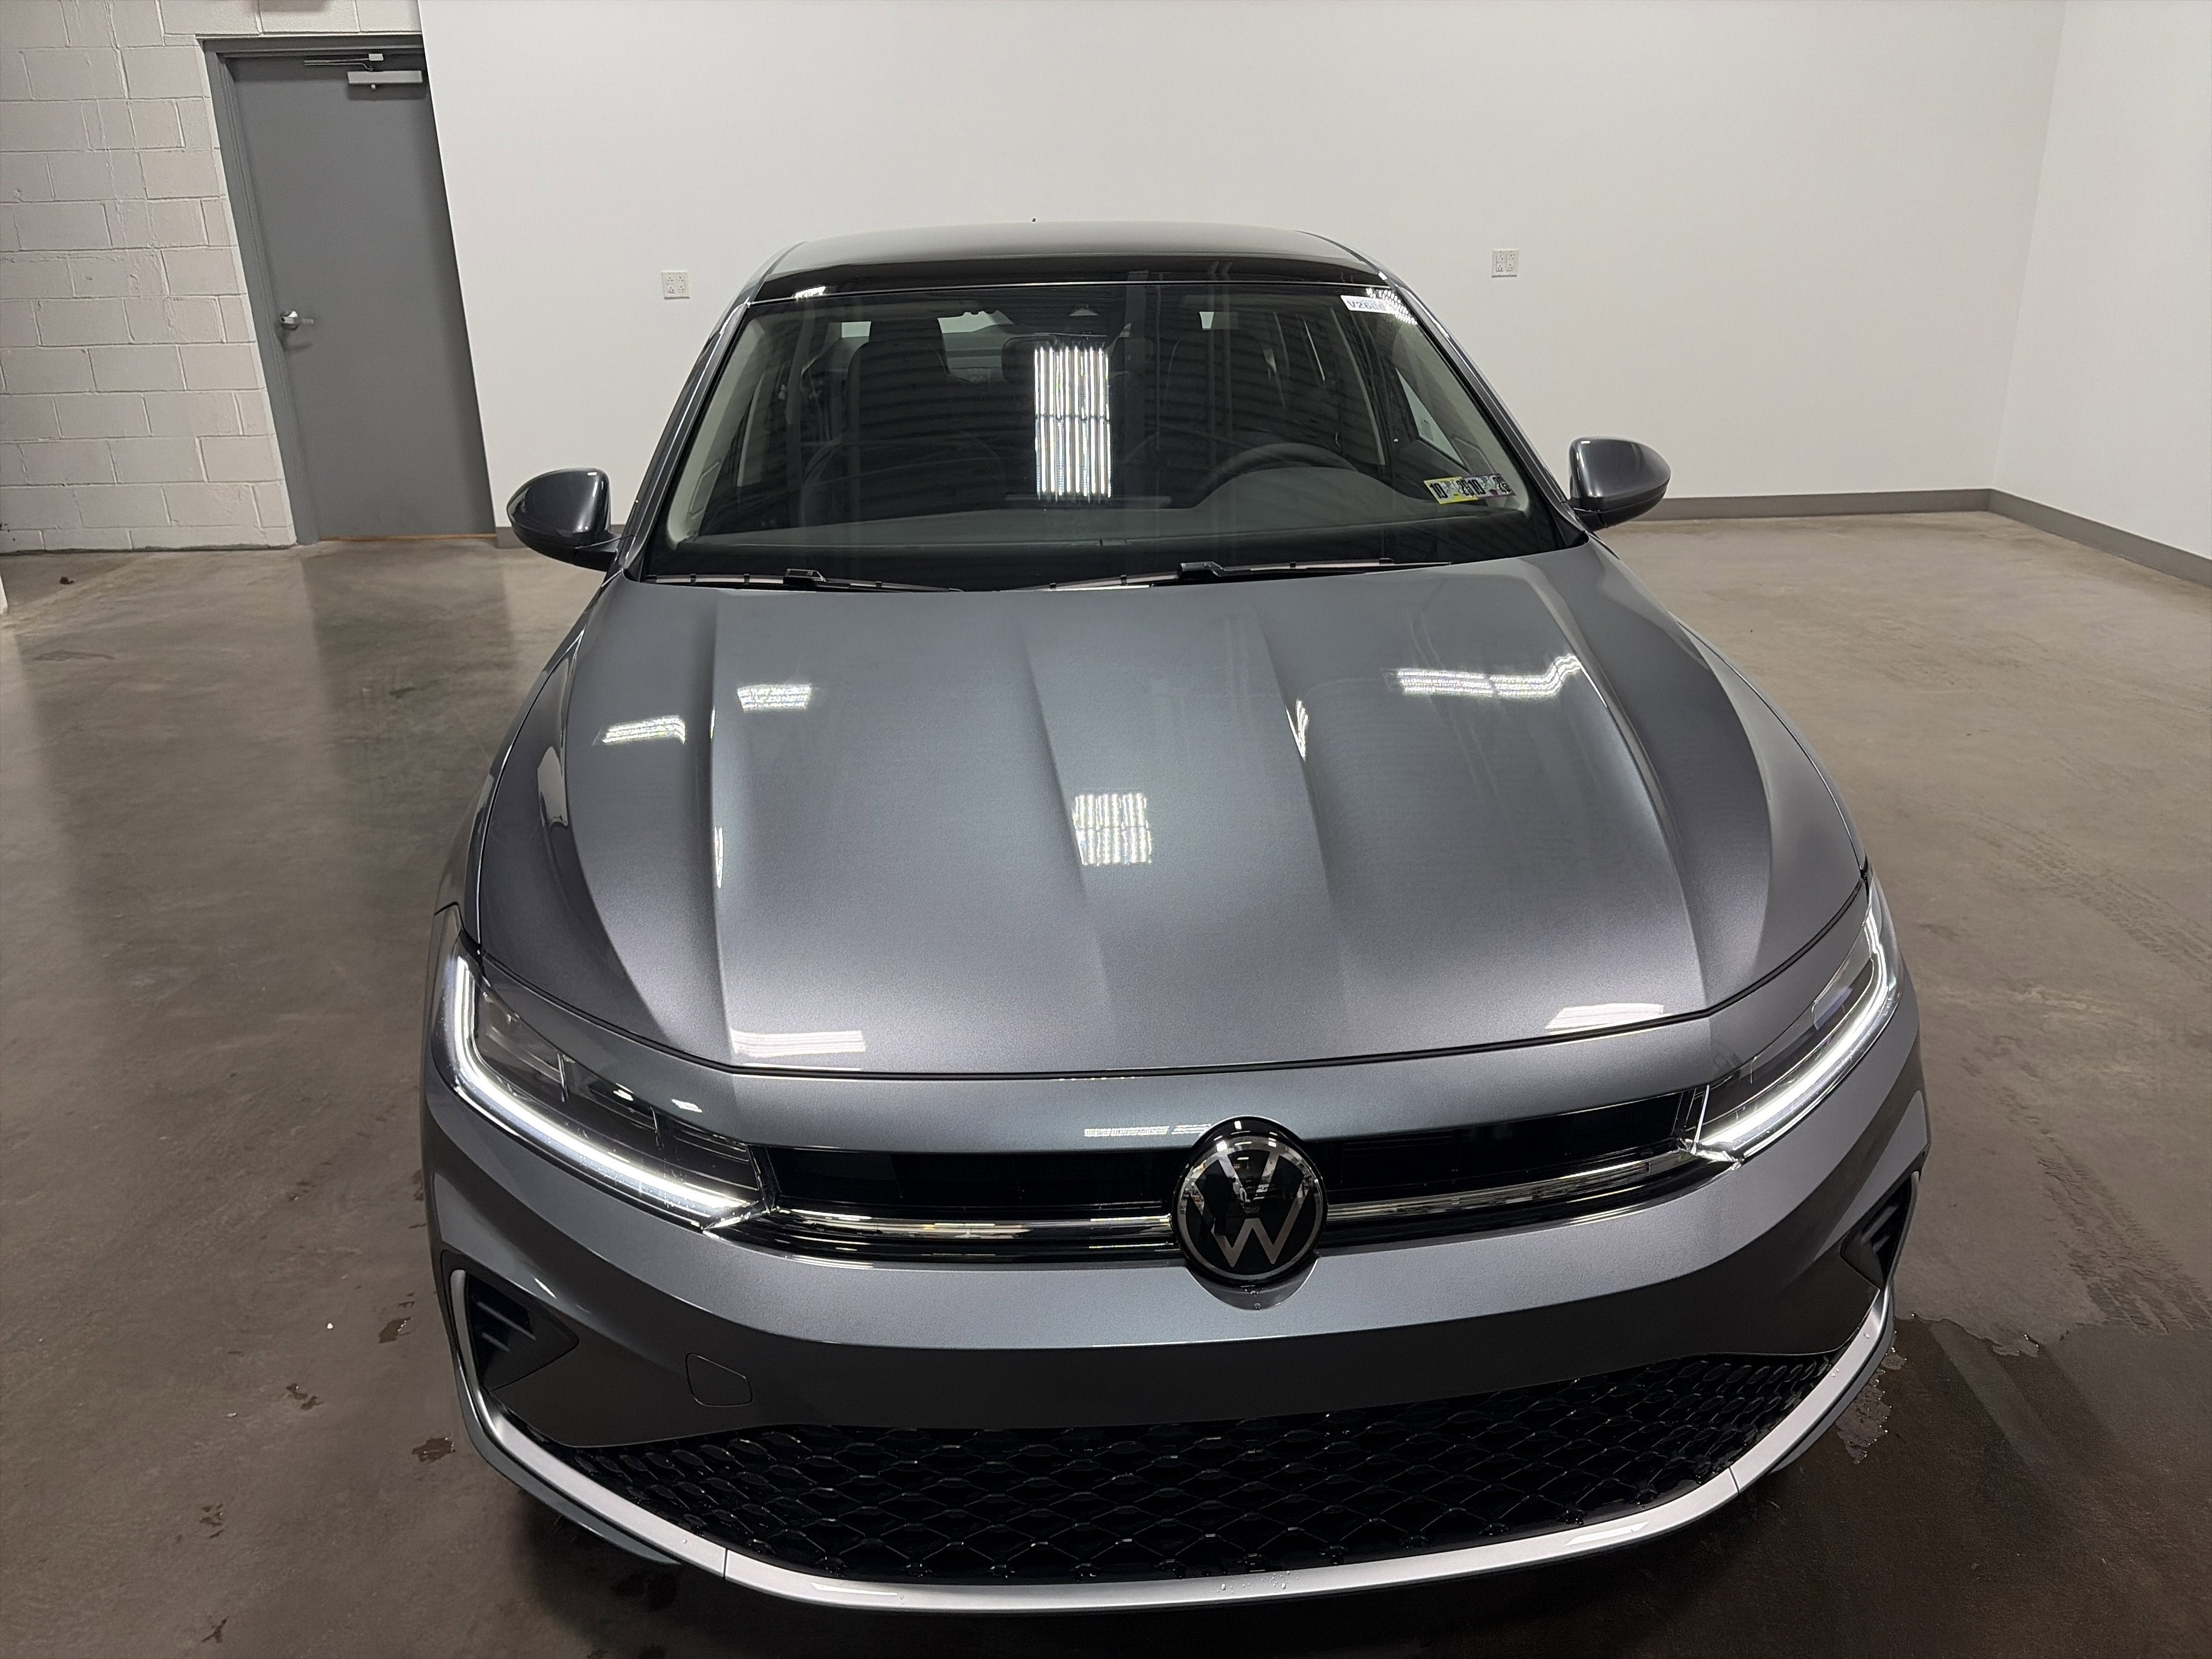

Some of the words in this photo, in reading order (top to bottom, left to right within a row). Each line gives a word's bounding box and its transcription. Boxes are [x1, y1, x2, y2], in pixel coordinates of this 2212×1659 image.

[1430, 483, 1448, 498] 10
[1468, 479, 1487, 495] 10
[1180, 1137, 1323, 1279] VW
